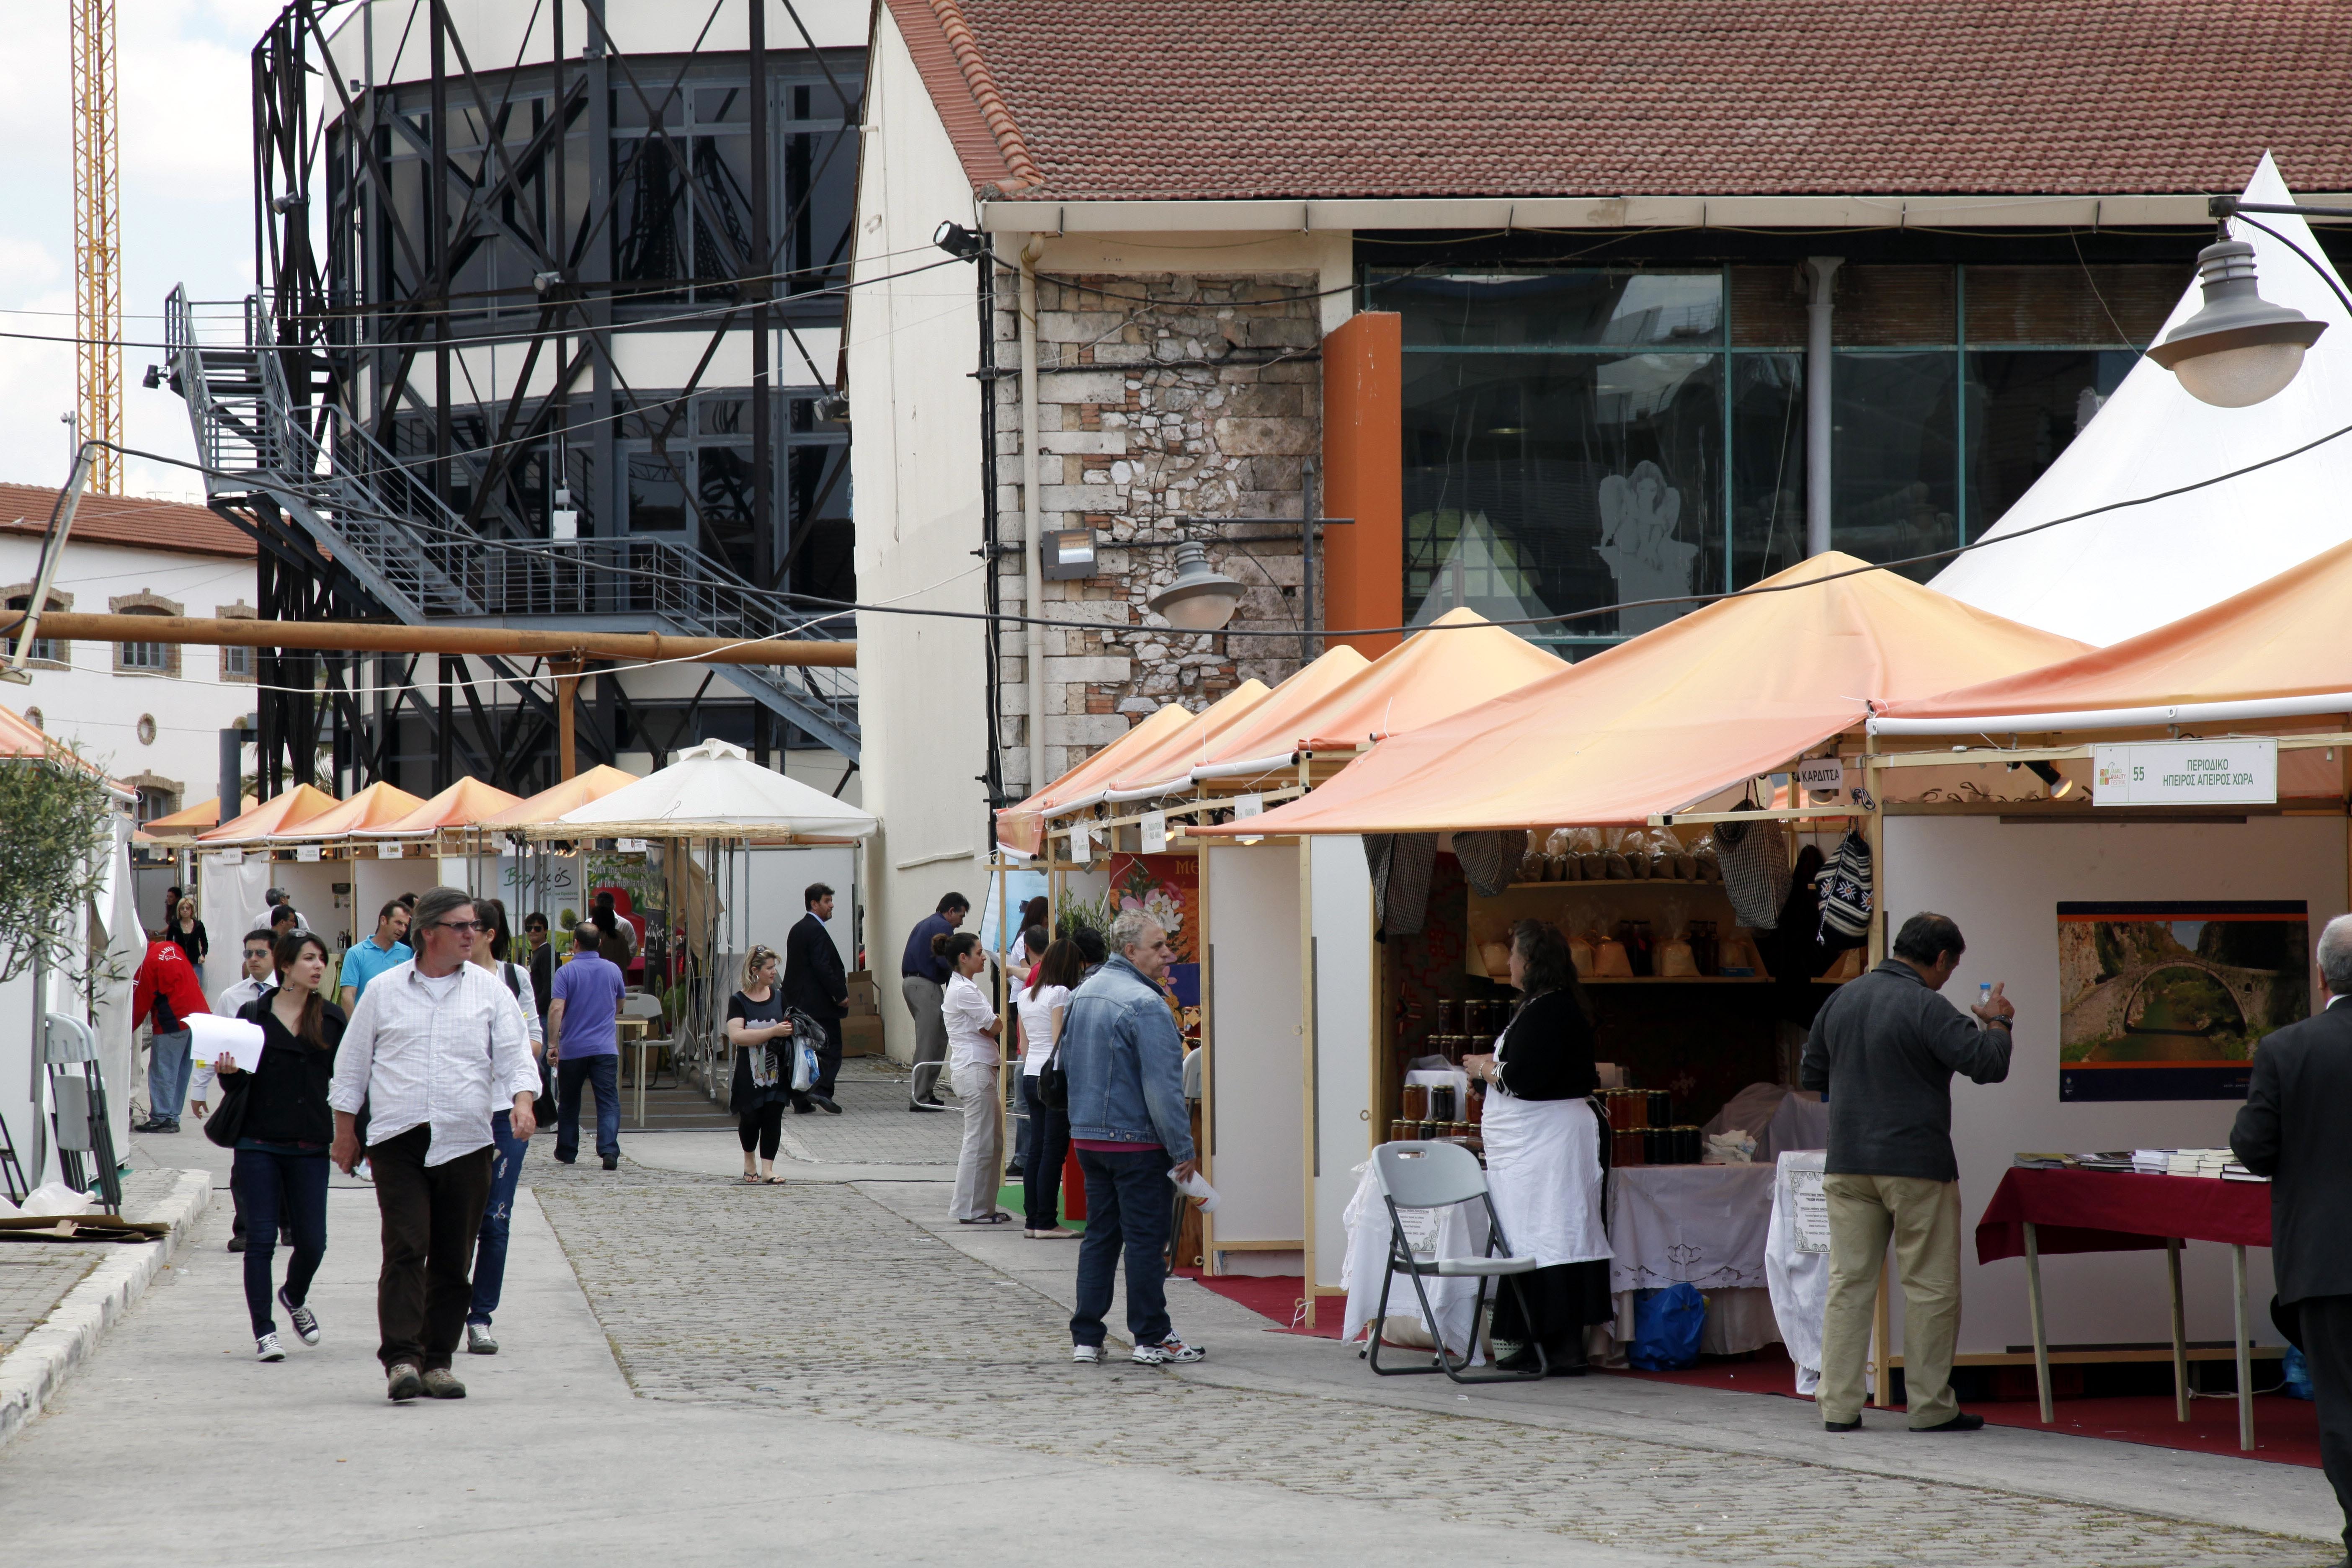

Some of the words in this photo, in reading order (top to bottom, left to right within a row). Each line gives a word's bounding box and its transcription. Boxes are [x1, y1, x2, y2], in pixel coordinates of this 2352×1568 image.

[2187, 759, 2228, 771] ΠΕΡΙΟΔΙΚΟ
[1802, 769, 1840, 782] ΚΑΡΔΙΤΣΑ
[2133, 766, 2144, 781] 55
[2163, 774, 2195, 786] ΗΠΕΙΡΟΣ
[2197, 774, 2231, 786] ΑΠΕΙΡΟΣ
[2232, 773, 2254, 785] ΧΩΡΑ
[593, 864, 606, 874] with
[608, 864, 618, 874] the
[620, 864, 649, 874] freshnes
[596, 879, 602, 888] of
[605, 878, 615, 887] the
[616, 878, 647, 890] highlands
